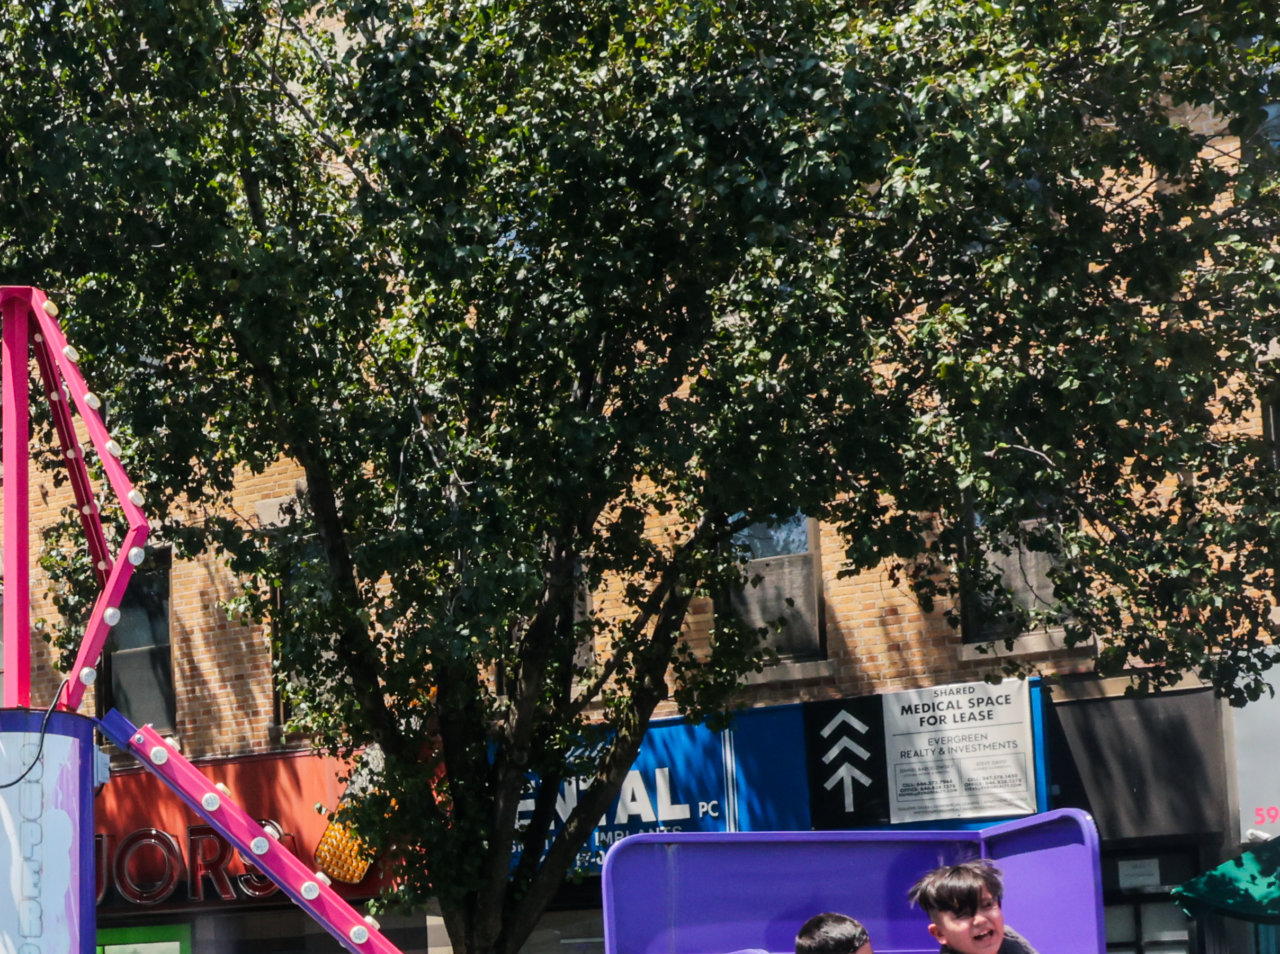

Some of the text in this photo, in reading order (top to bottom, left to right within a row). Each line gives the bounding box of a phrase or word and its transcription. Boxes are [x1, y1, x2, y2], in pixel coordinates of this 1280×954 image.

[933, 686, 975, 698] SHARED
[900, 694, 1012, 716] MEDICAL SPACE
[919, 709, 994, 727] FOR LEASE
[928, 733, 988, 746] EVERGREEN
[900, 740, 1018, 759] REALTY & INVESTMENTS
[698, 800, 719, 818] PC
[1254, 805, 1279, 826] 59
[19, 741, 44, 939] SUPER
